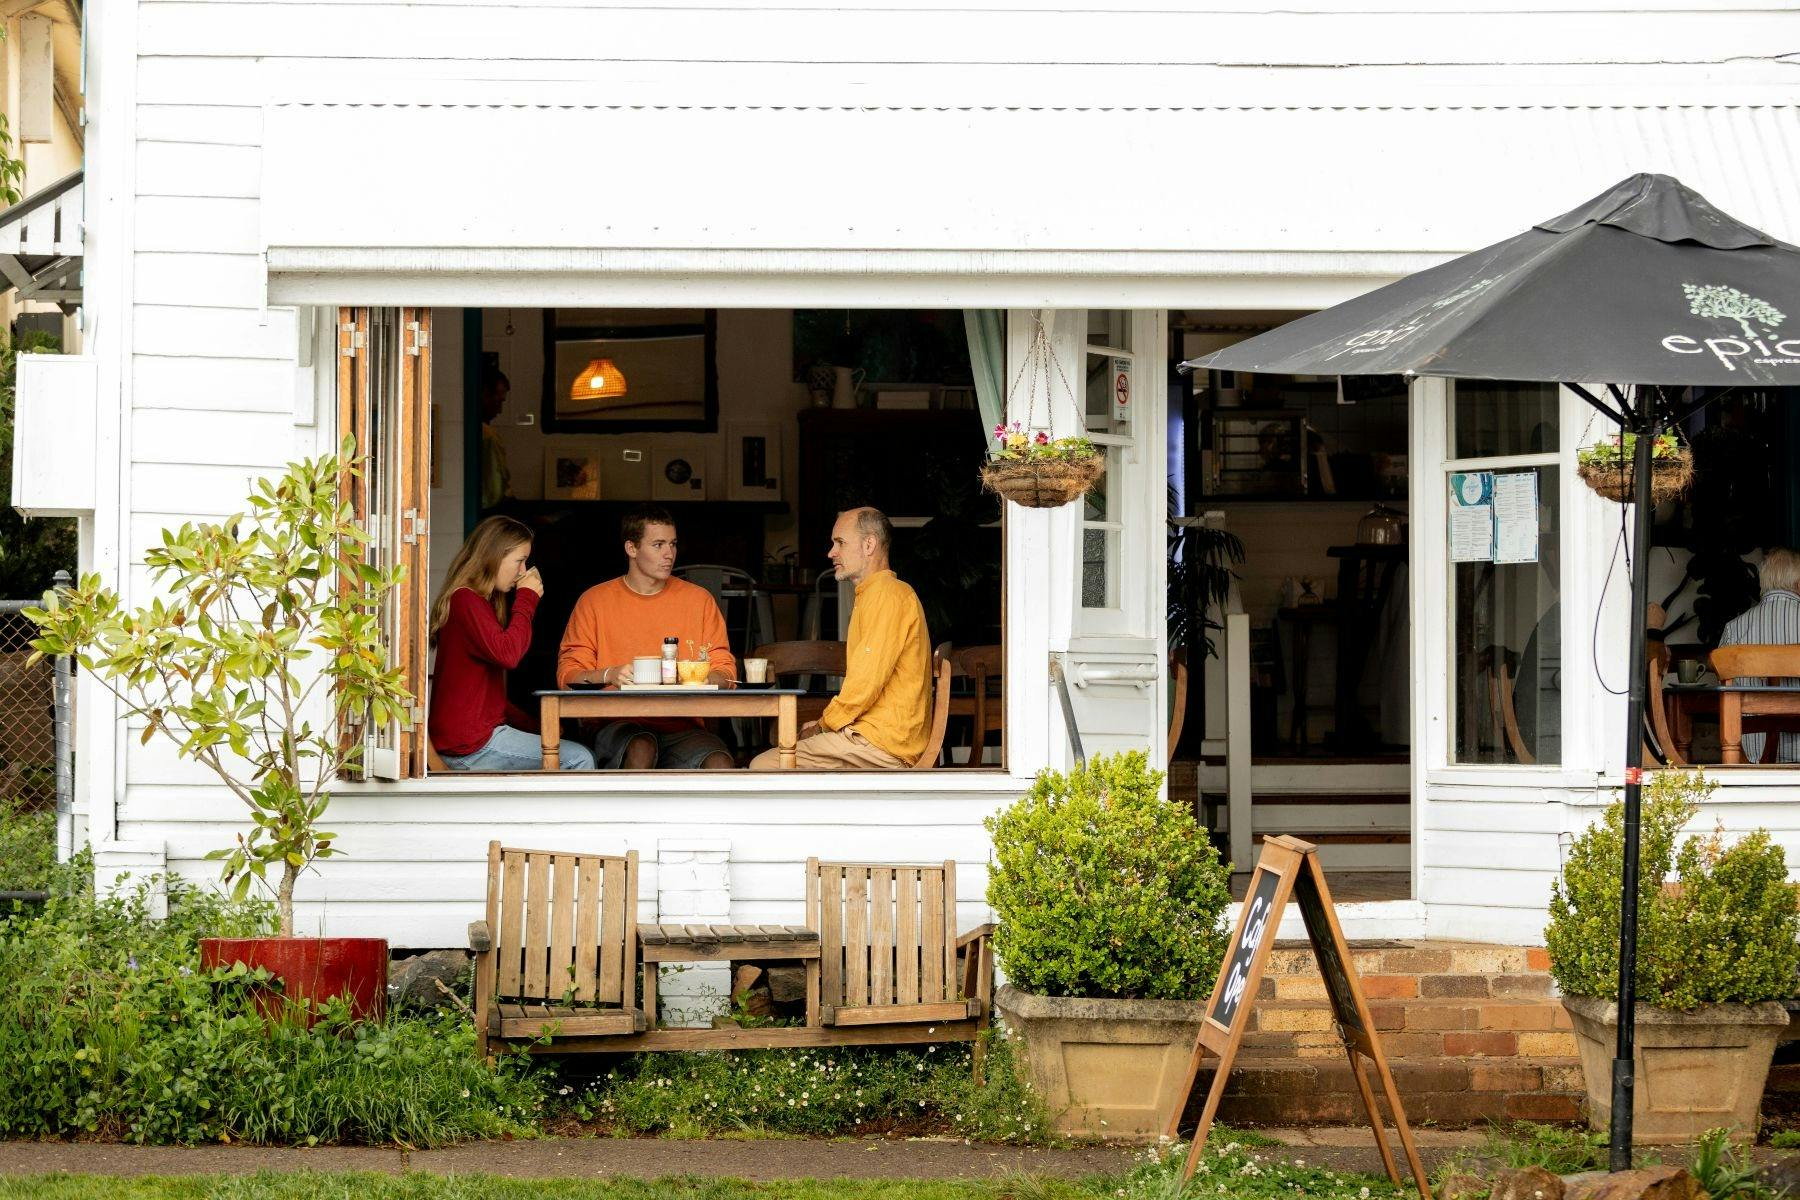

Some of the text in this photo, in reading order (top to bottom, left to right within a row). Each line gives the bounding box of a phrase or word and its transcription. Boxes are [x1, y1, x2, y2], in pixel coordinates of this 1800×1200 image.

[1661, 334, 1800, 371] epic
[1242, 896, 1272, 967] Caf
[1224, 961, 1246, 1015] Ope
